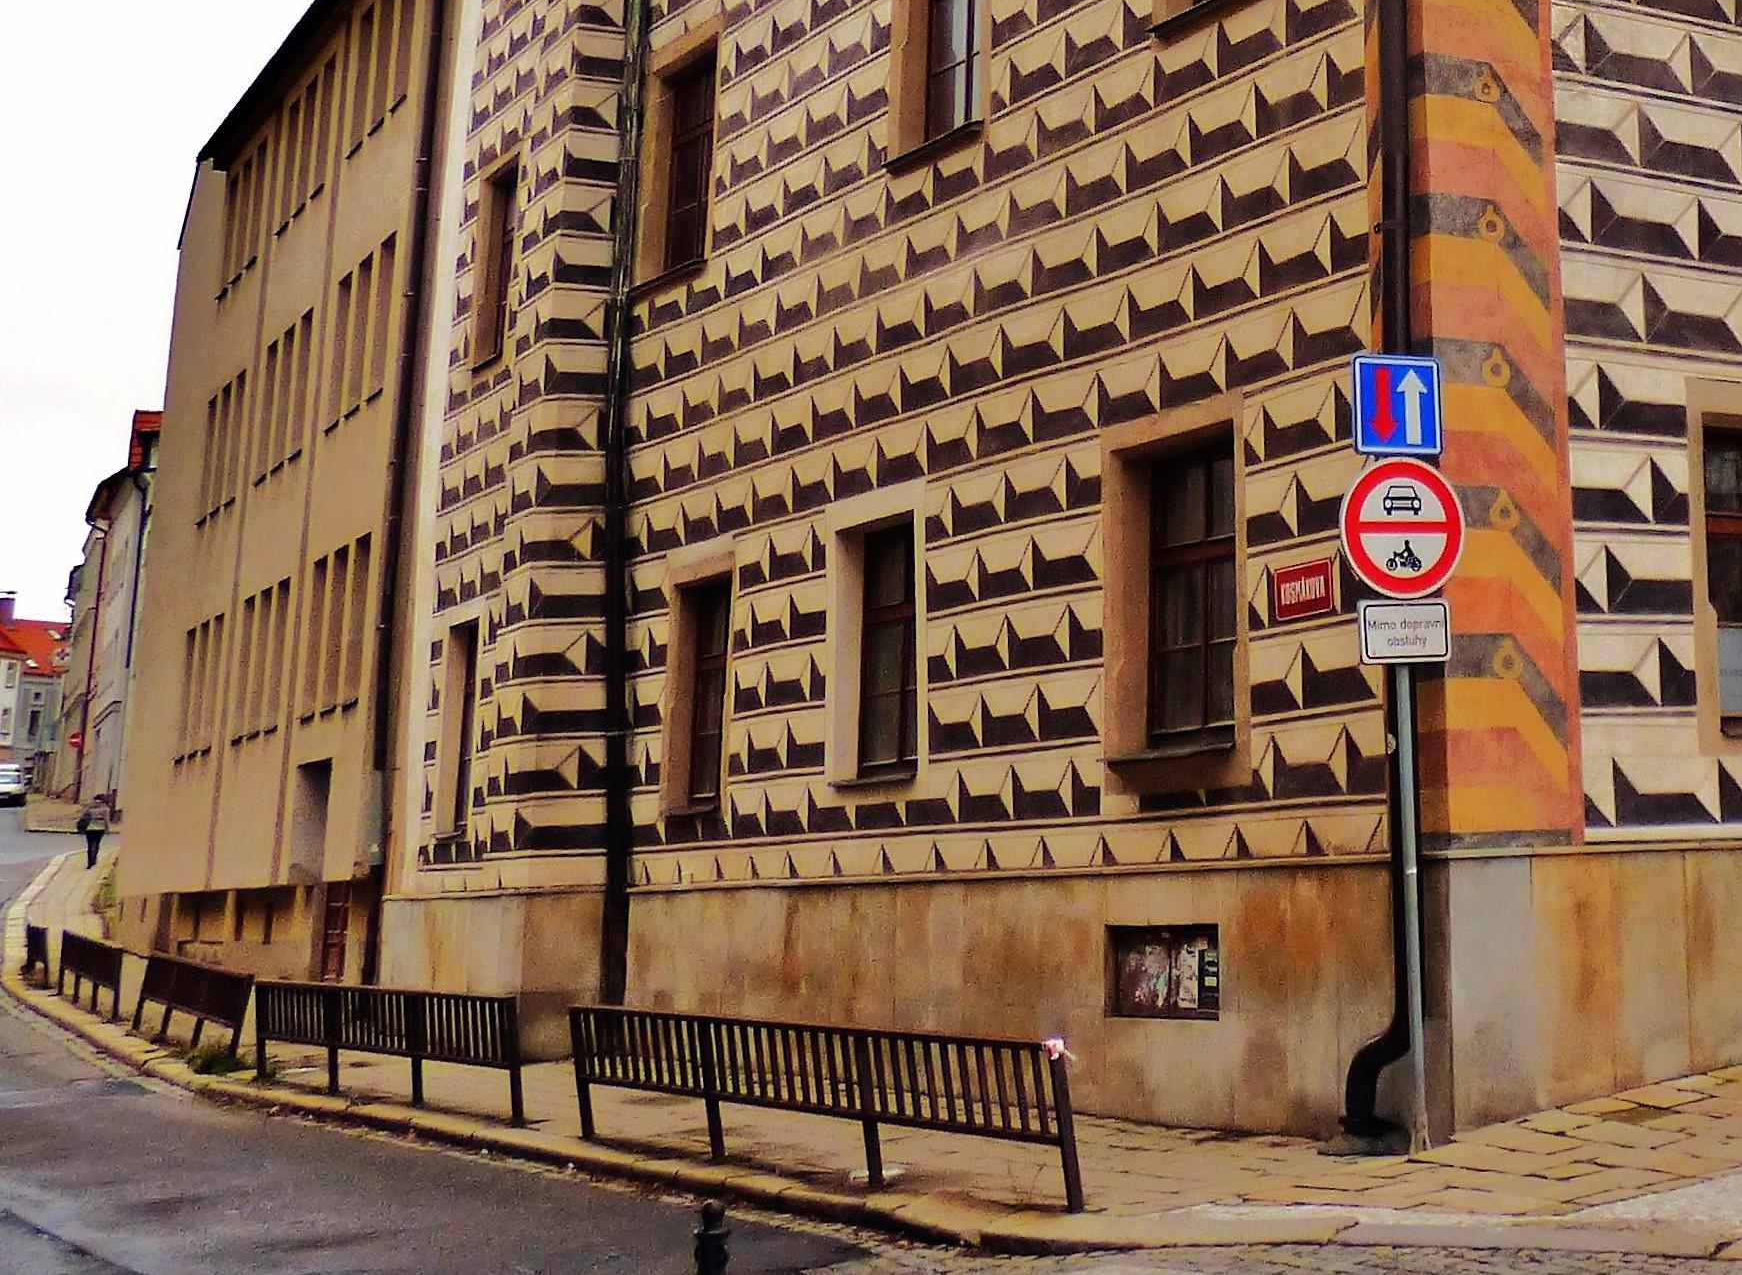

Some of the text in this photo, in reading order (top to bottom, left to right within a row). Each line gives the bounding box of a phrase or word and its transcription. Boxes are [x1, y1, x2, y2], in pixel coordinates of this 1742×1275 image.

[1281, 575, 1325, 606] KOSMÁKOVA
[1368, 620, 1396, 631] Mimo
[1387, 634, 1427, 648] obsluhy
